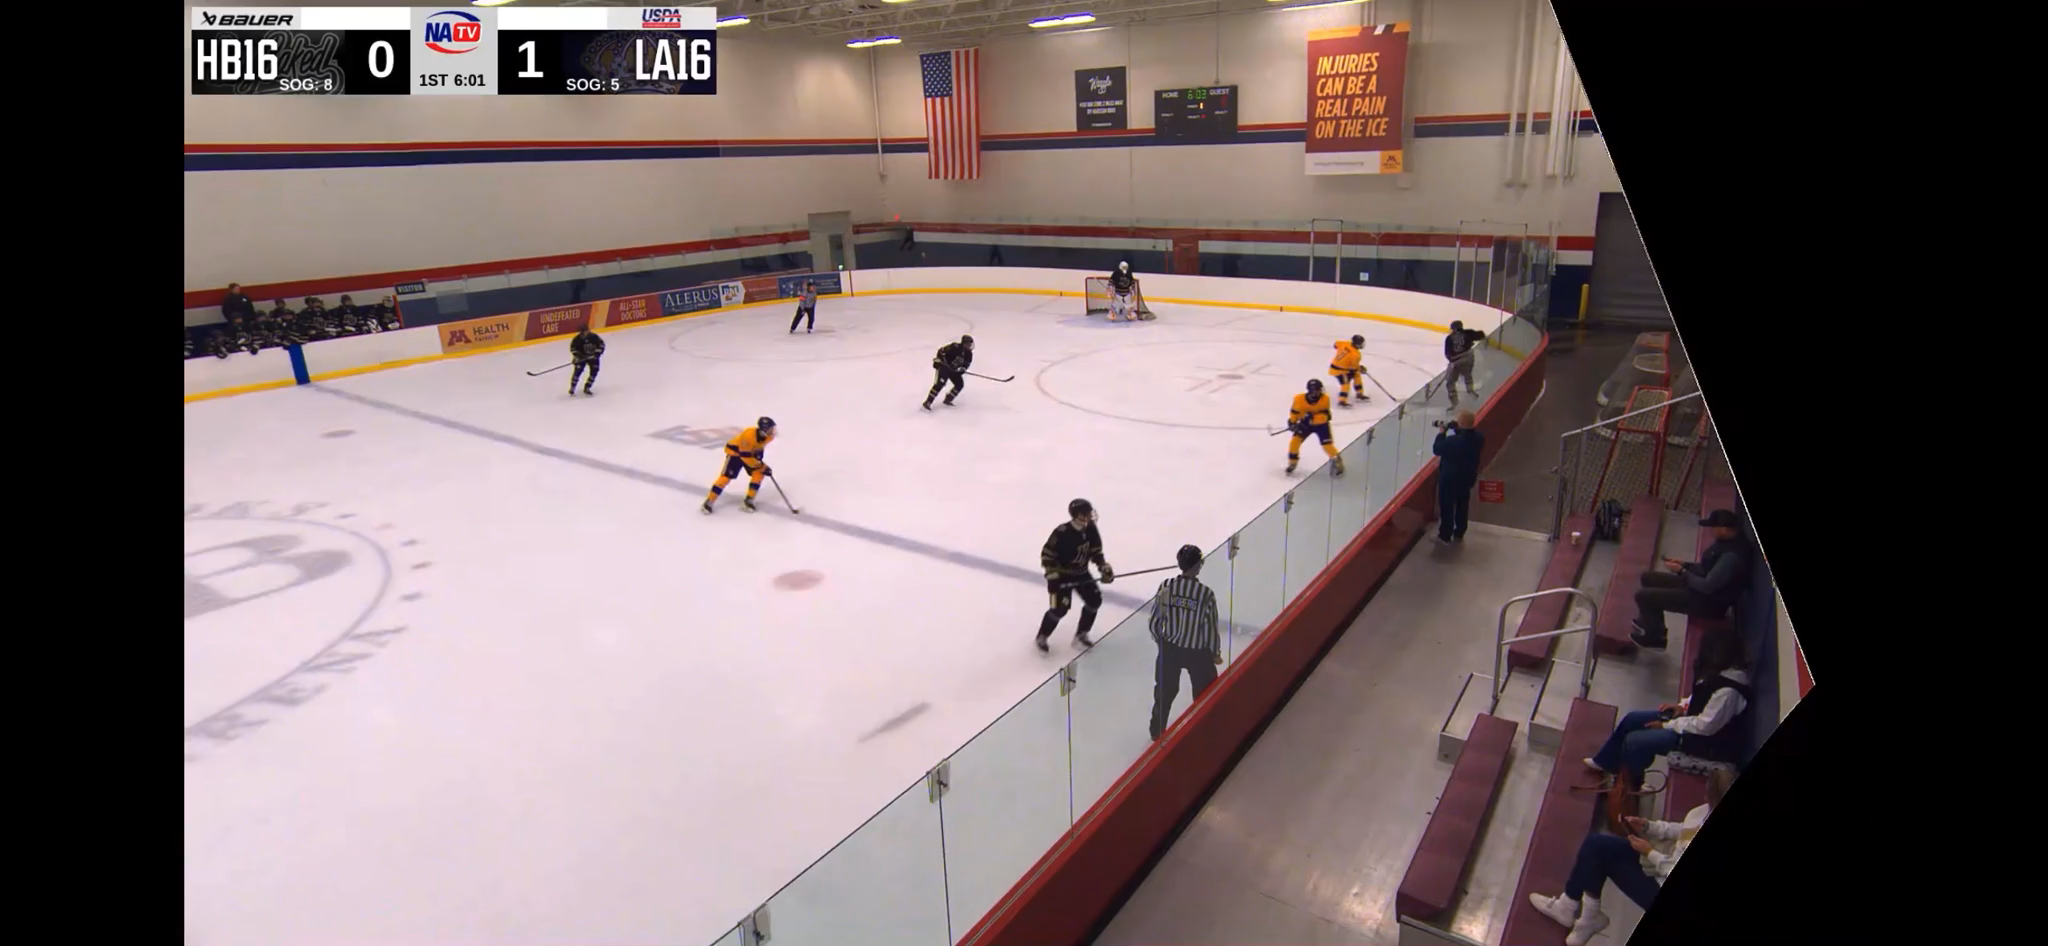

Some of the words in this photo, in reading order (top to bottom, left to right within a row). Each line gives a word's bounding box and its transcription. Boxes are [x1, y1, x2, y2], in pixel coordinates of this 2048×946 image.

[1316, 52, 1380, 76] INJURIES
[1209, 88, 1230, 96] GUEST
[1316, 77, 1345, 97] CAN
[1346, 75, 1366, 95] BE
[1366, 74, 1377, 94] A
[1315, 98, 1348, 118] REAL
[1351, 95, 1387, 116] PAIN
[1315, 120, 1336, 139] ON
[1338, 118, 1366, 138] THE
[1366, 117, 1389, 137] ICE
[620, 299, 646, 311] ALL-STAR
[664, 287, 719, 308] ALERUS
[540, 309, 580, 324] UNDEFEATED
[621, 309, 647, 321] DOCTORS
[473, 323, 510, 337] HEALTH
[542, 322, 559, 334] CARE
